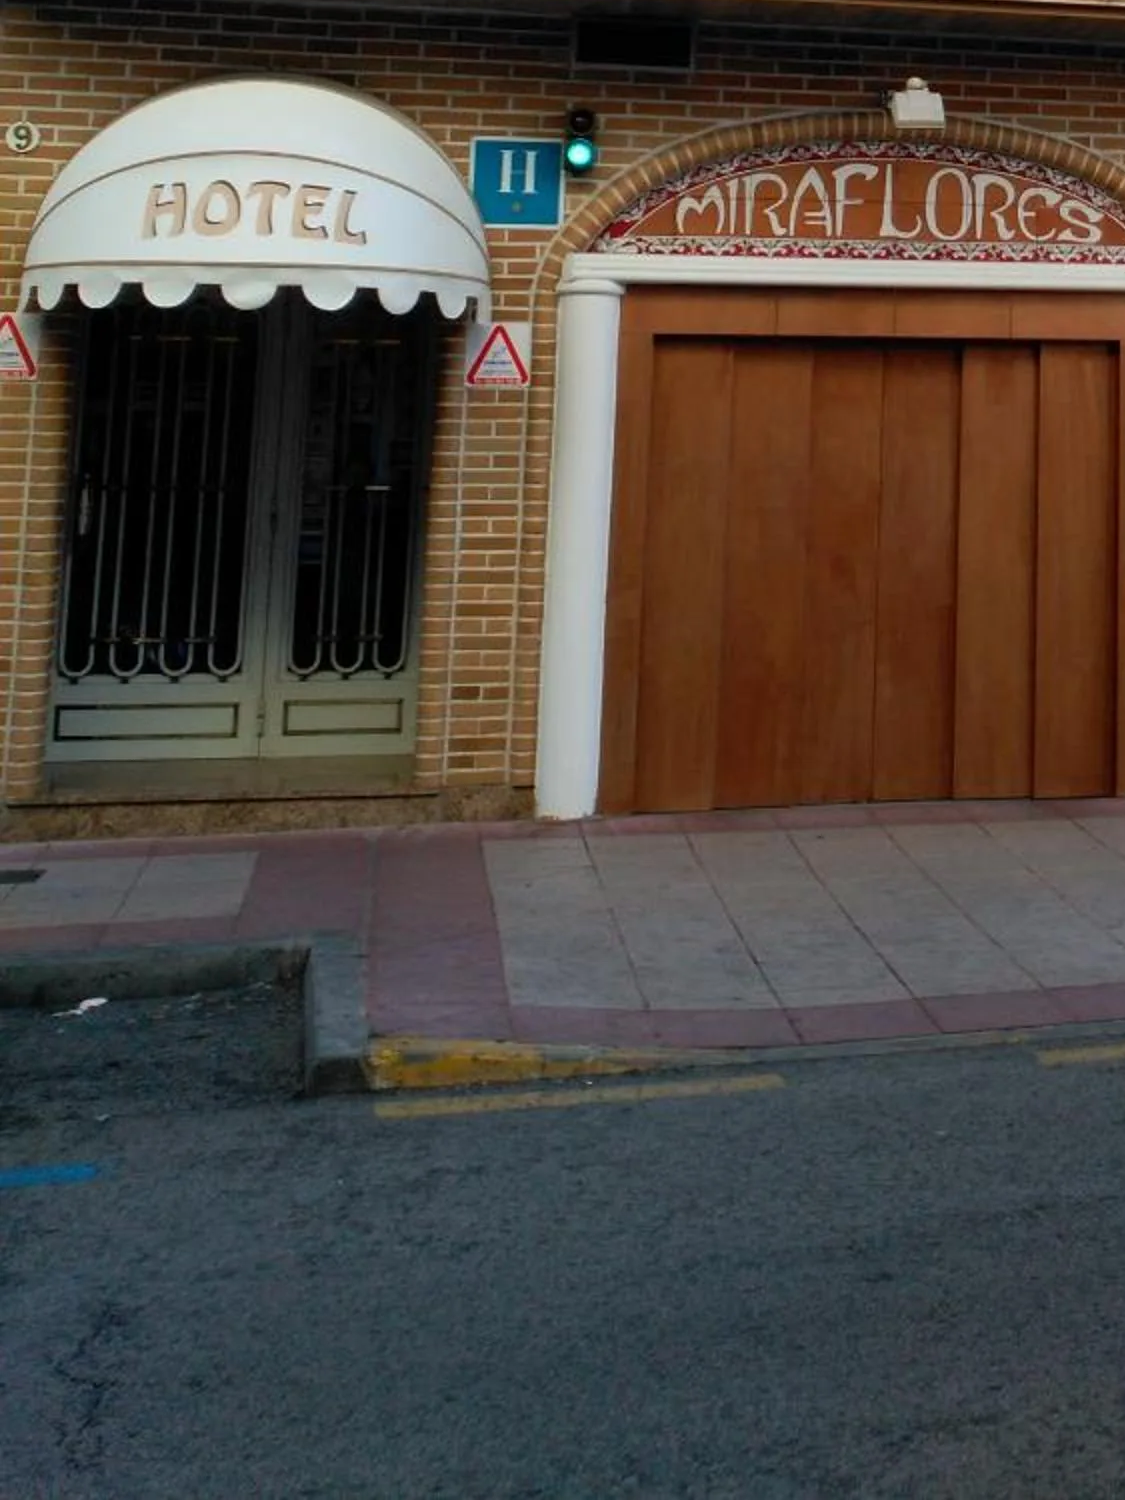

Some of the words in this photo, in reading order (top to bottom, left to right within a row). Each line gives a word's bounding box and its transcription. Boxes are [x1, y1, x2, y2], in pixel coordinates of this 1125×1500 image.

[13, 124, 32, 150] 9
[141, 178, 367, 245] HOTEL
[674, 162, 1106, 243] MIRAFLORES
